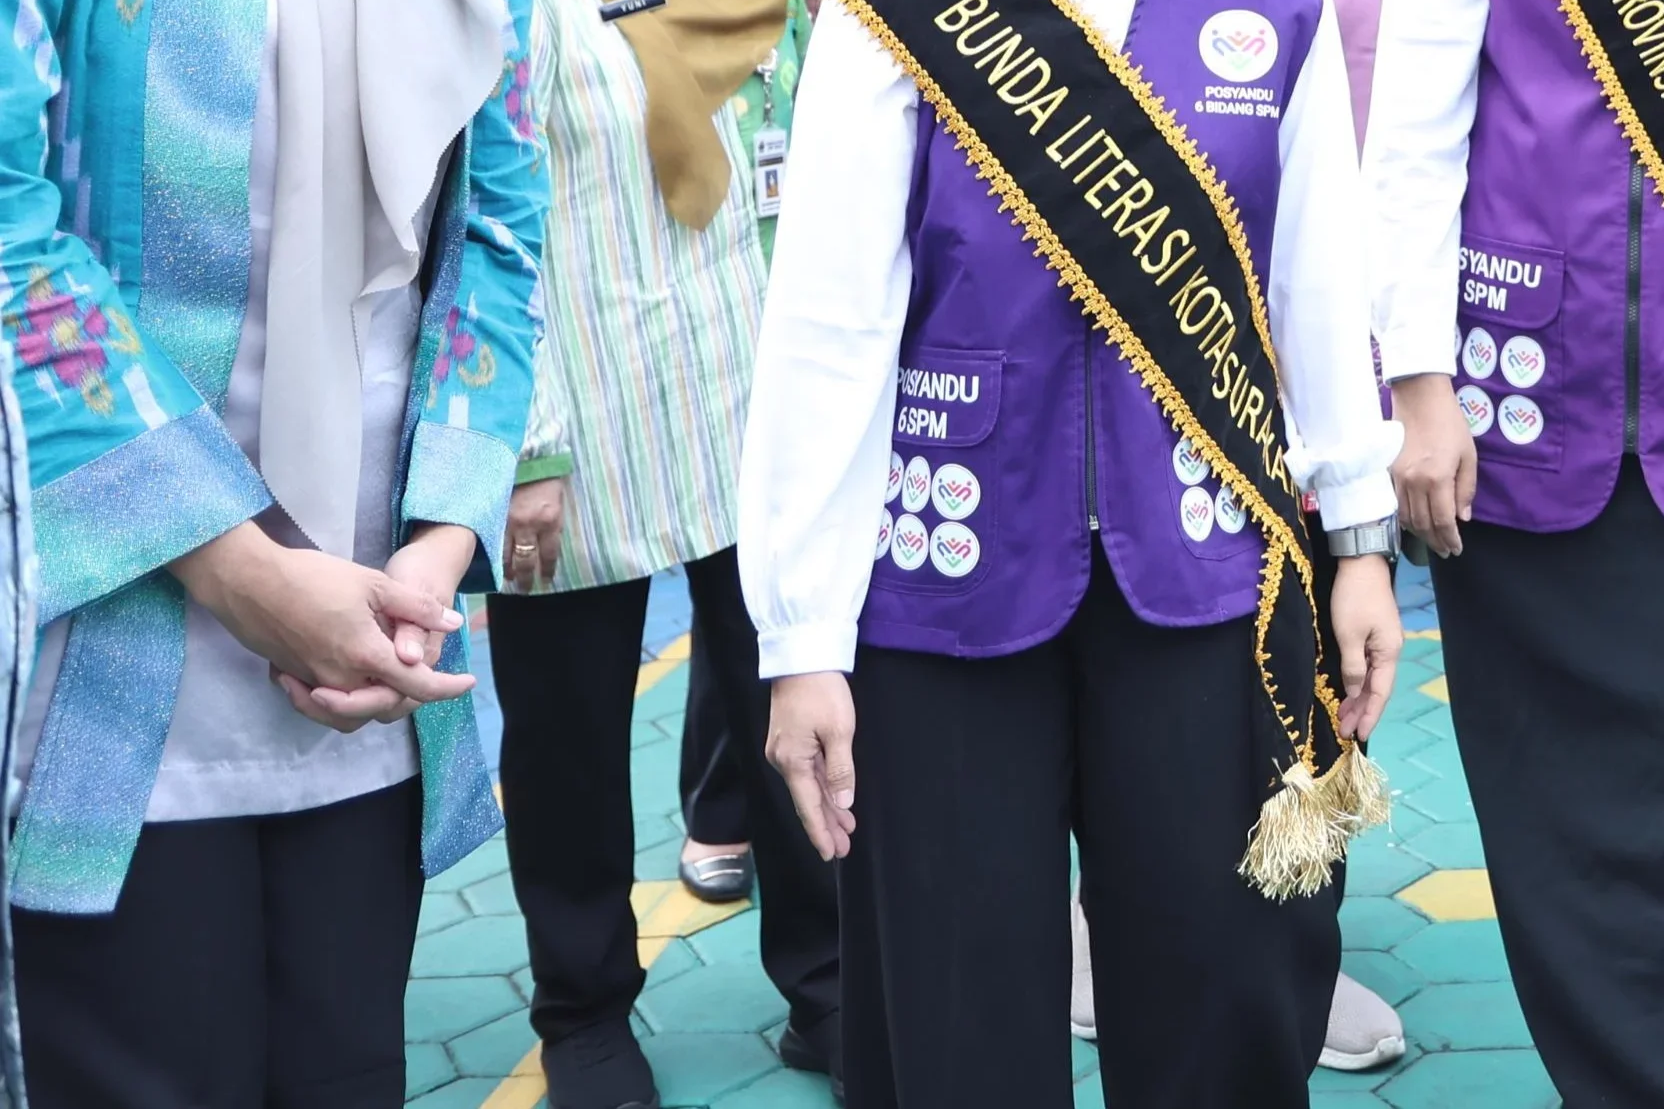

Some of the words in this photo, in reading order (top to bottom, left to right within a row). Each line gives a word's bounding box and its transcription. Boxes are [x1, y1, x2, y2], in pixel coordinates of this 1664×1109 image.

[1194, 100, 1204, 113] 6
[1205, 100, 1254, 116] BIDANG
[1255, 103, 1280, 119] SPM
[1205, 86, 1274, 102] POSYANDU
[1045, 114, 1197, 286] LITERASI
[1460, 246, 1542, 288] SYANDU
[1463, 278, 1507, 312] SPM
